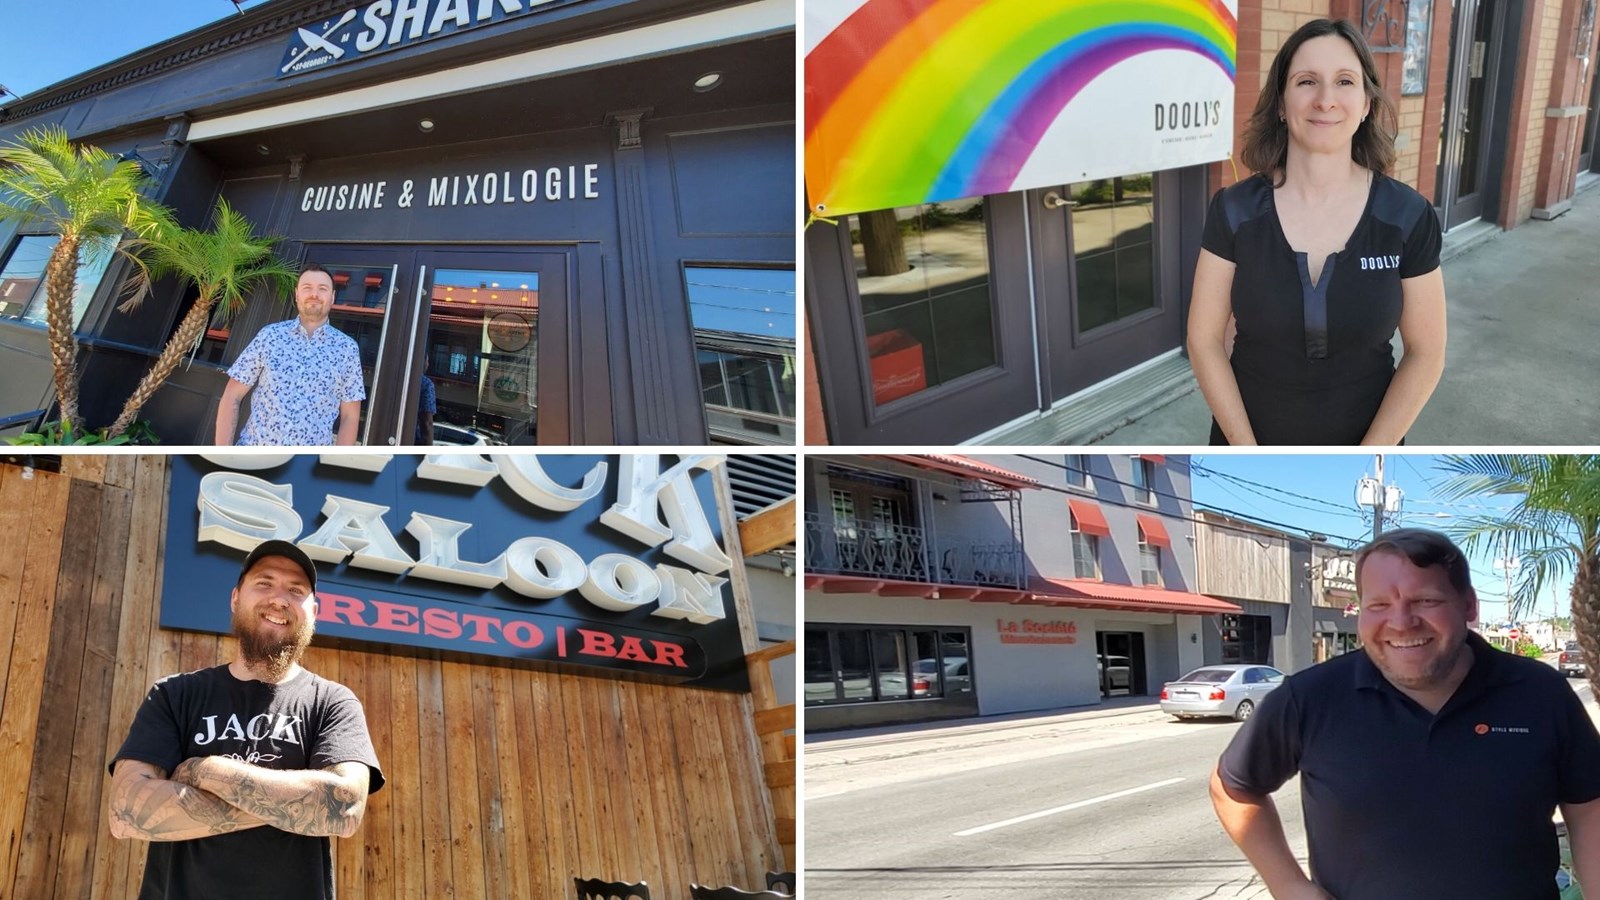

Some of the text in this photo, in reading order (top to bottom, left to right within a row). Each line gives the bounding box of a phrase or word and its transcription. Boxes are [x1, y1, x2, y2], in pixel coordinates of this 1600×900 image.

[1155, 100, 1221, 131] DOOLY'S
[301, 163, 599, 212] CUISINE & MIXOLOGIE
[198, 471, 729, 625] SALOON
[316, 592, 545, 650] RESTO
[577, 628, 689, 668] BAR
[194, 713, 302, 745] JACK
